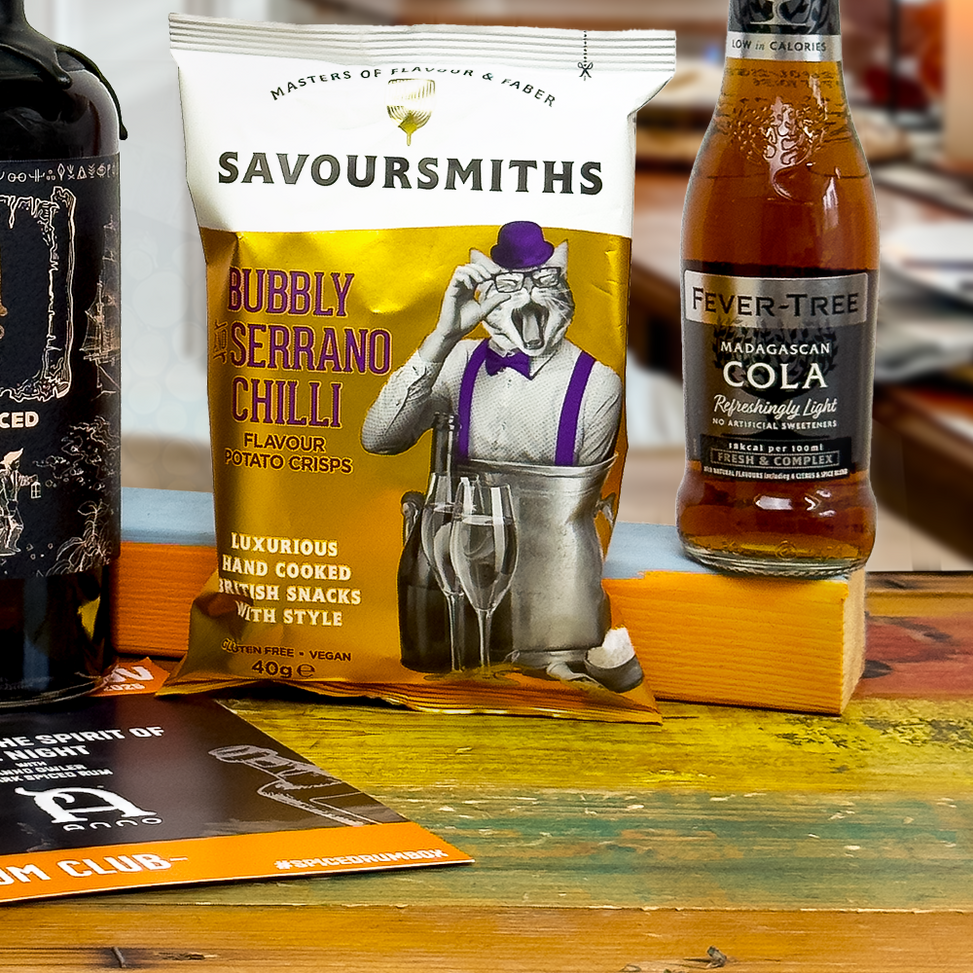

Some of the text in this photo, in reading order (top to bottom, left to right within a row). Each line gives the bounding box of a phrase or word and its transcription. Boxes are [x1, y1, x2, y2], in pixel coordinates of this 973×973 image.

[731, 39, 827, 52] LOW in CALORIES
[270, 66, 557, 108] MASTERS OF FLAVOUR & FABER
[218, 150, 604, 196] SAVOURSMITHS
[228, 266, 355, 317] BUBBLY
[692, 286, 860, 317] FEVER-TREE
[230, 321, 393, 376] SERRANO
[720, 341, 831, 356] MADAGASCAN
[723, 360, 829, 390] COLA
[232, 376, 344, 429] CHILLI
[713, 394, 838, 420] Refreshingly Light
[712, 416, 838, 431] NO ARTIFICIAL SWEETENERS
[243, 432, 327, 454] FLAVOUR
[767, 444, 788, 454] per
[791, 443, 824, 453] 100ml
[225, 447, 354, 474] POTATO CRISPS
[717, 451, 833, 466] FRESH & COMPLEX
[231, 532, 339, 557] LUXURIOUS
[222, 554, 352, 582] HAND COOKED
[286, 585, 362, 605] SNACKS
[234, 600, 343, 627] WITH STYLE
[264, 646, 294, 658] FREE
[309, 650, 352, 662] VEGAN
[252, 660, 293, 678] 40g
[34, 728, 127, 747] SPIRIT
[129, 726, 166, 739] OF
[5, 744, 91, 762] NIGHT
[15, 760, 48, 769] WITH
[23, 771, 80, 783] SPICED
[77, 768, 114, 778] RUM
[35, 763, 87, 775] OWLER
[273, 848, 449, 871] #SPICEDRUMBOX
